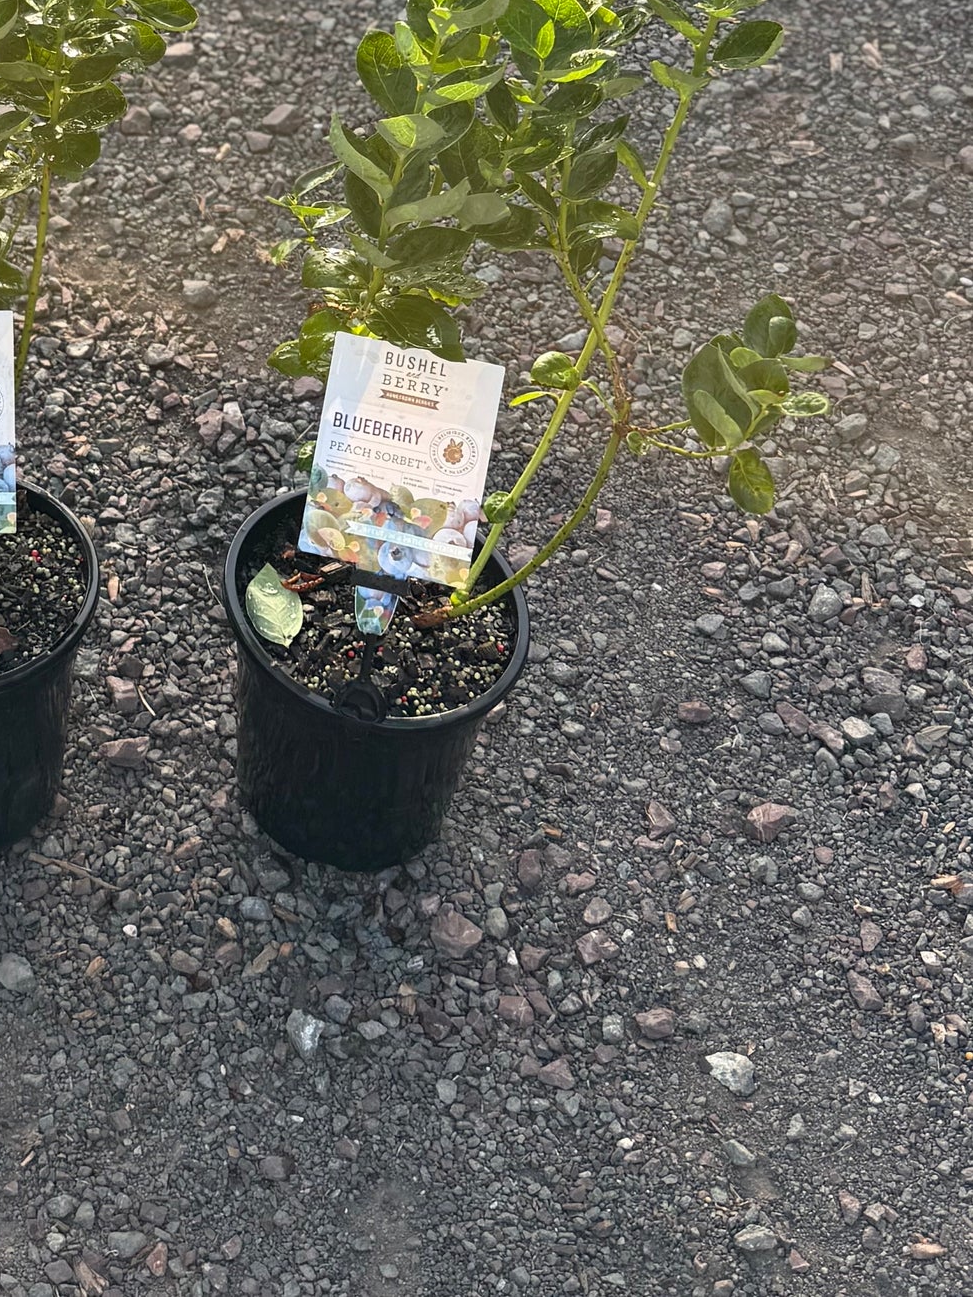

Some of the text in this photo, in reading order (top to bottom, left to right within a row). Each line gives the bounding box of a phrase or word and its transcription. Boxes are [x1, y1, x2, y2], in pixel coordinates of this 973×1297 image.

[385, 351, 447, 377] BUSHEL
[382, 374, 445, 397] BERRY
[332, 411, 424, 446] BLUEBERRY
[329, 440, 372, 459] PEACH
[374, 451, 425, 470] SORBET
